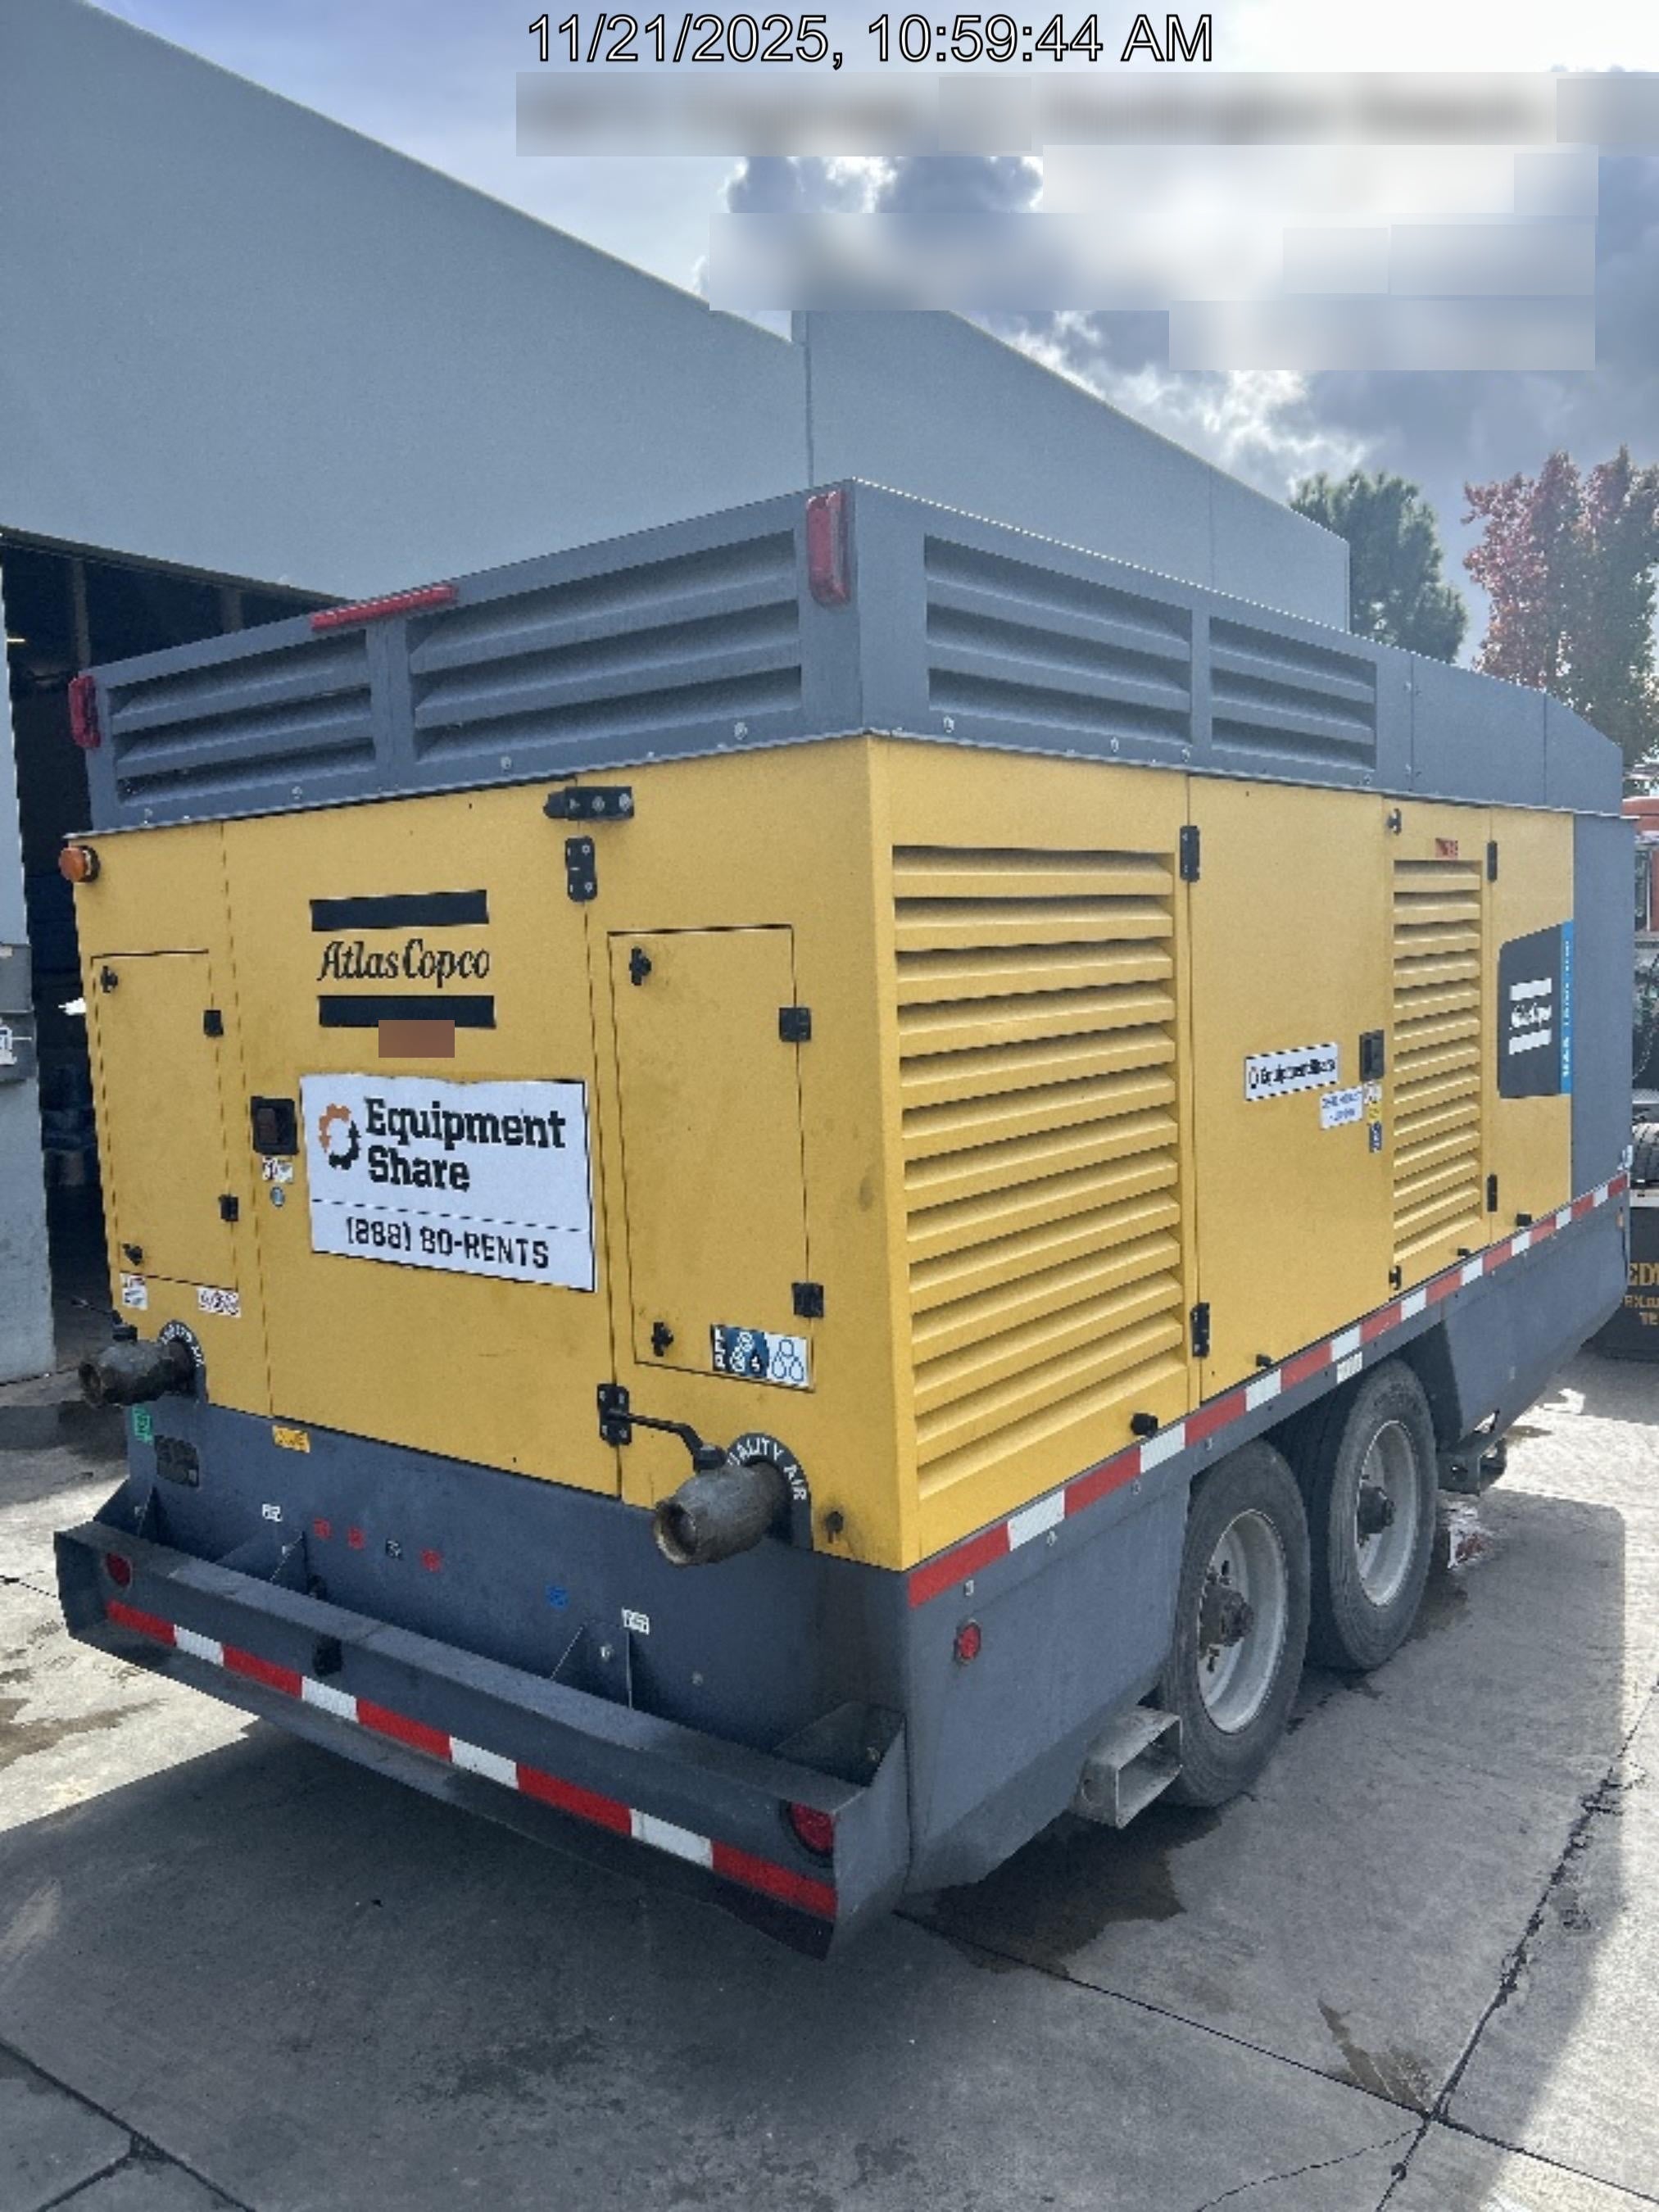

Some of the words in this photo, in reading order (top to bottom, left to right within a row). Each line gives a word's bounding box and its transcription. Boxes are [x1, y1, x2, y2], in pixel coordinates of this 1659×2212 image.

[316, 940, 400, 981] Atlas
[402, 938, 491, 989] Copco
[365, 1097, 566, 1150] Equipment
[368, 1145, 470, 1192] Share
